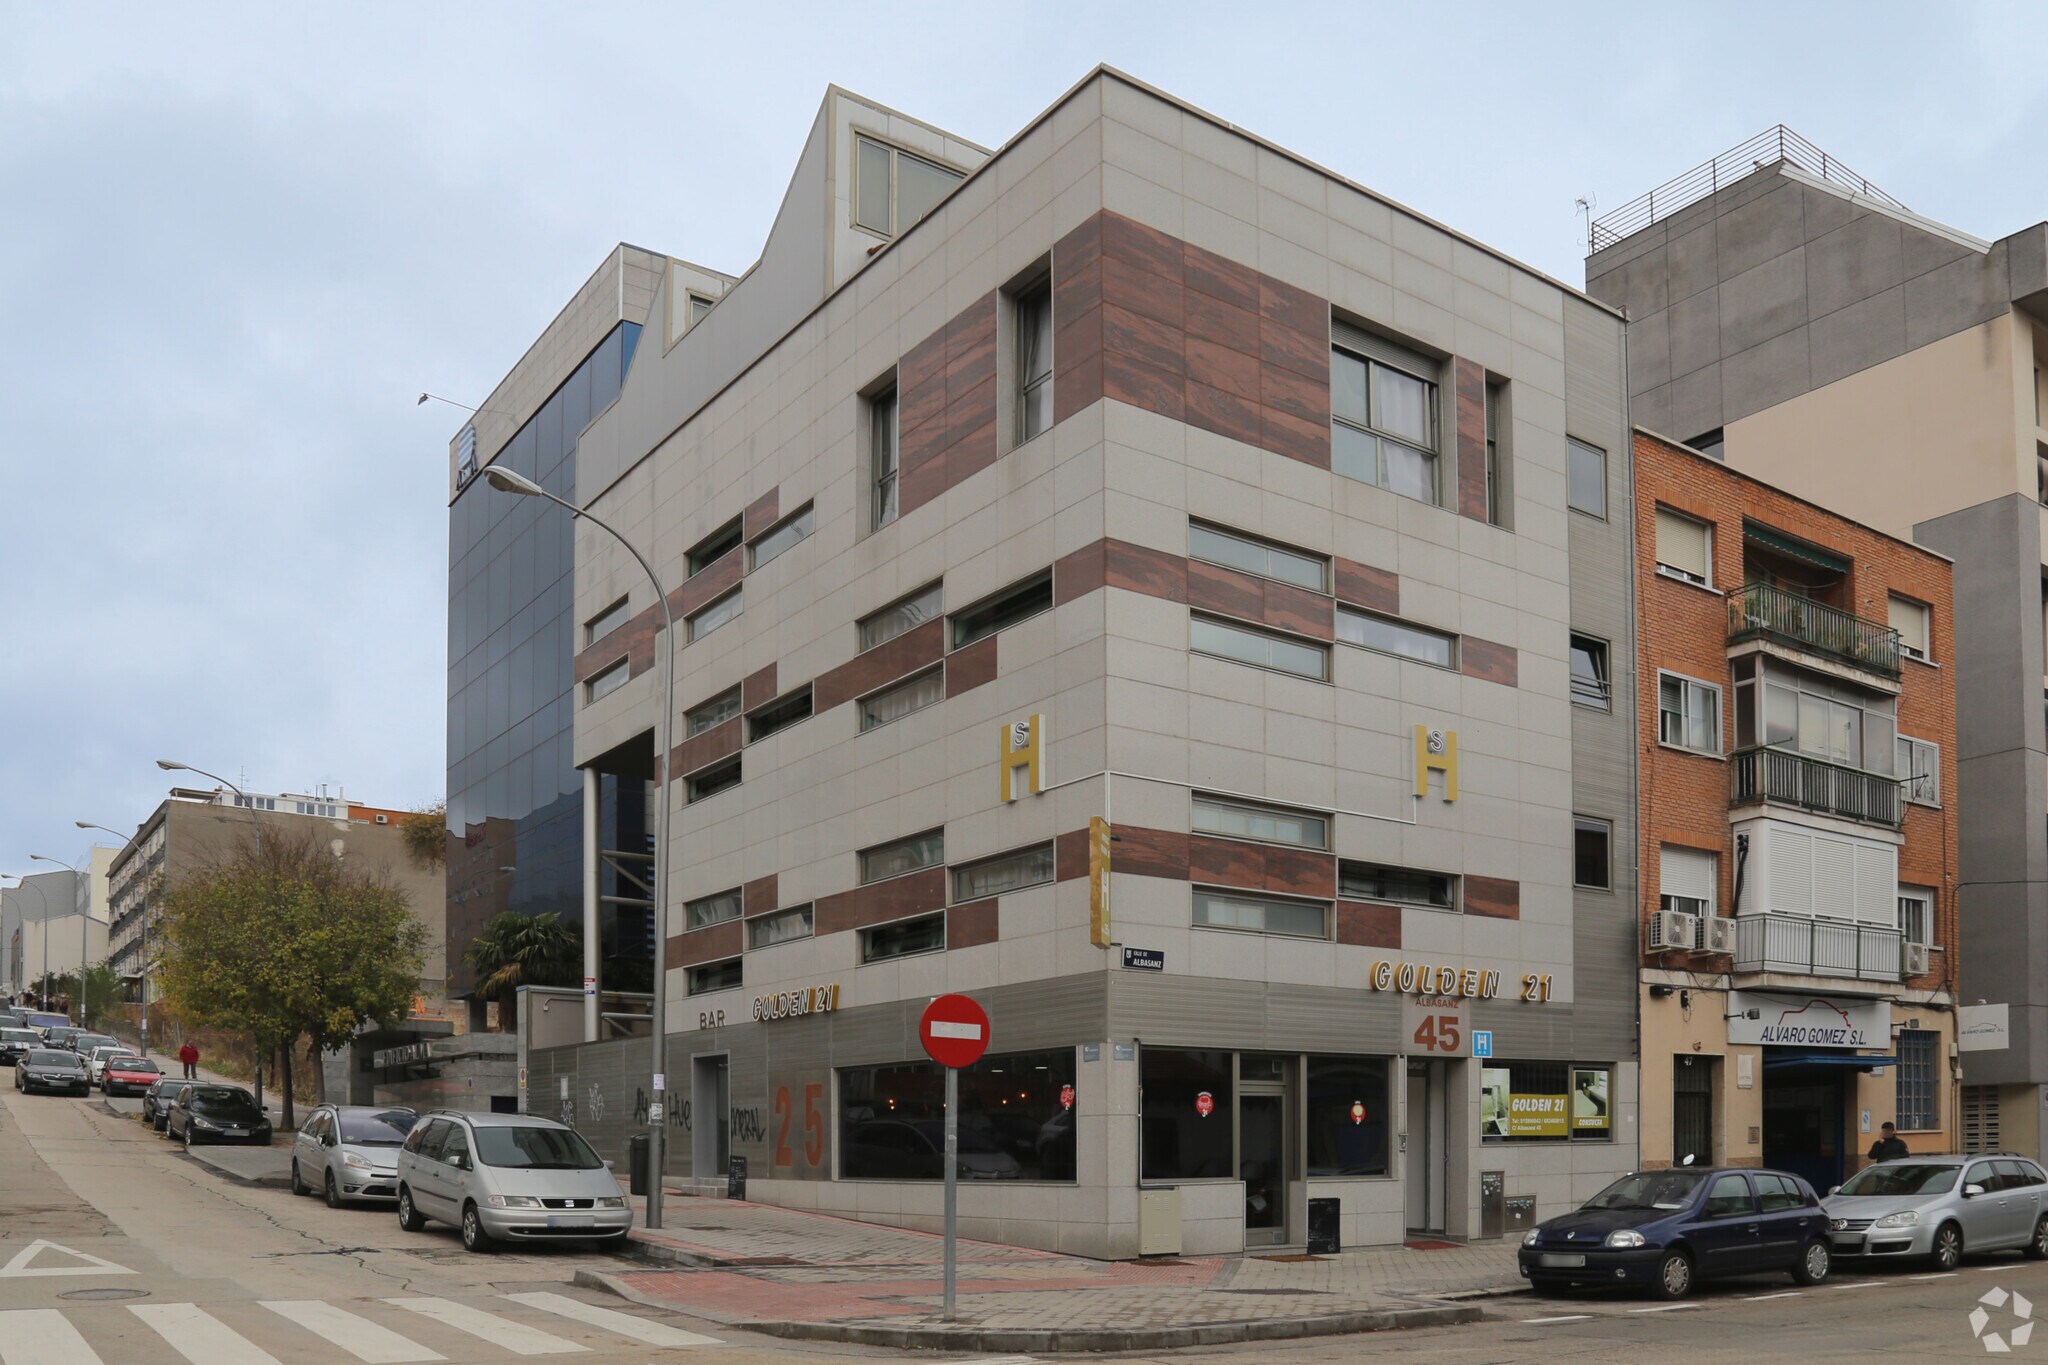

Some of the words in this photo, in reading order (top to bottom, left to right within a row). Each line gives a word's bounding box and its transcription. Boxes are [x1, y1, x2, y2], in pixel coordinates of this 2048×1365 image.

[1133, 958, 1162, 969] ALBASANZ
[1370, 961, 1501, 999] GOLDEN
[1522, 973, 1553, 1003] 21
[752, 987, 813, 1021] GOLDEN
[815, 983, 838, 1013] 21
[1415, 997, 1459, 1009] ALBASANZ
[700, 1009, 726, 1030] BAR
[1414, 1015, 1460, 1052] 45
[1760, 1026, 1806, 1043] ALVARO
[1808, 1028, 1846, 1045] GOMEZ
[1850, 1030, 1867, 1046] S.L.
[1684, 1056, 1693, 1066] 47
[1512, 1098, 1552, 1112] GOLDEN
[1554, 1099, 1565, 1112] 21
[775, 1084, 823, 1168] 25
